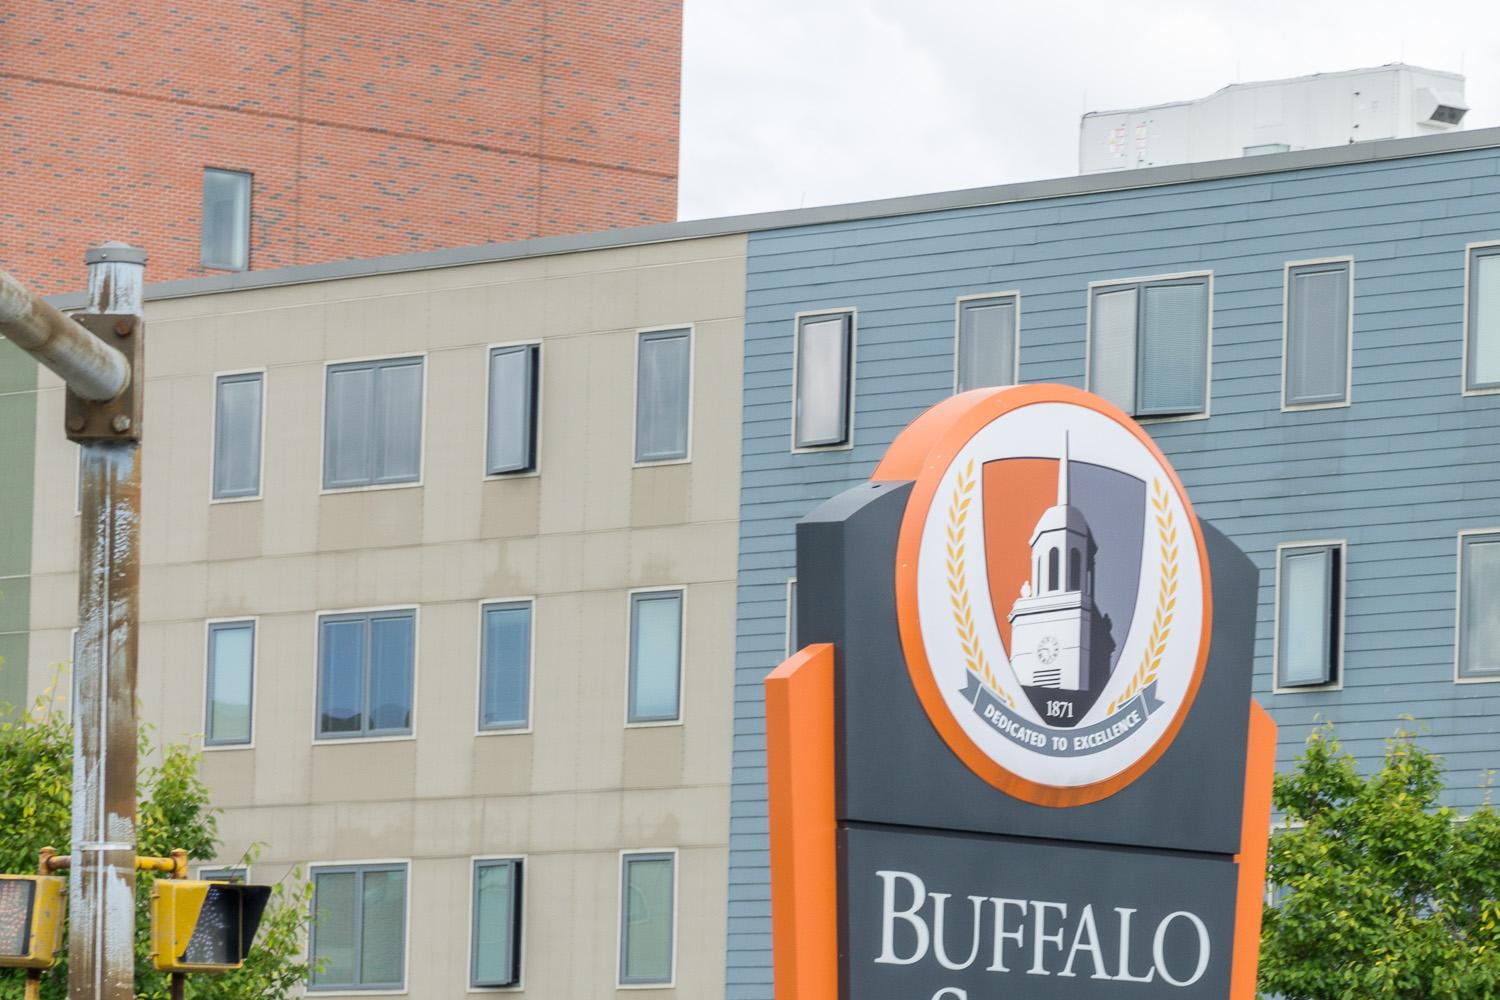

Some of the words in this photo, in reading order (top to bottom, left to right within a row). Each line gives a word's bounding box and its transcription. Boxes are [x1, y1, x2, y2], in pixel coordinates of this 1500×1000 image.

[983, 703, 1047, 748] DEDICATED
[1052, 736, 1067, 751] TO
[1073, 710, 1142, 751] EXCELLENCE
[1045, 700, 1074, 719] 1871
[874, 870, 1211, 987] BUFFALO
